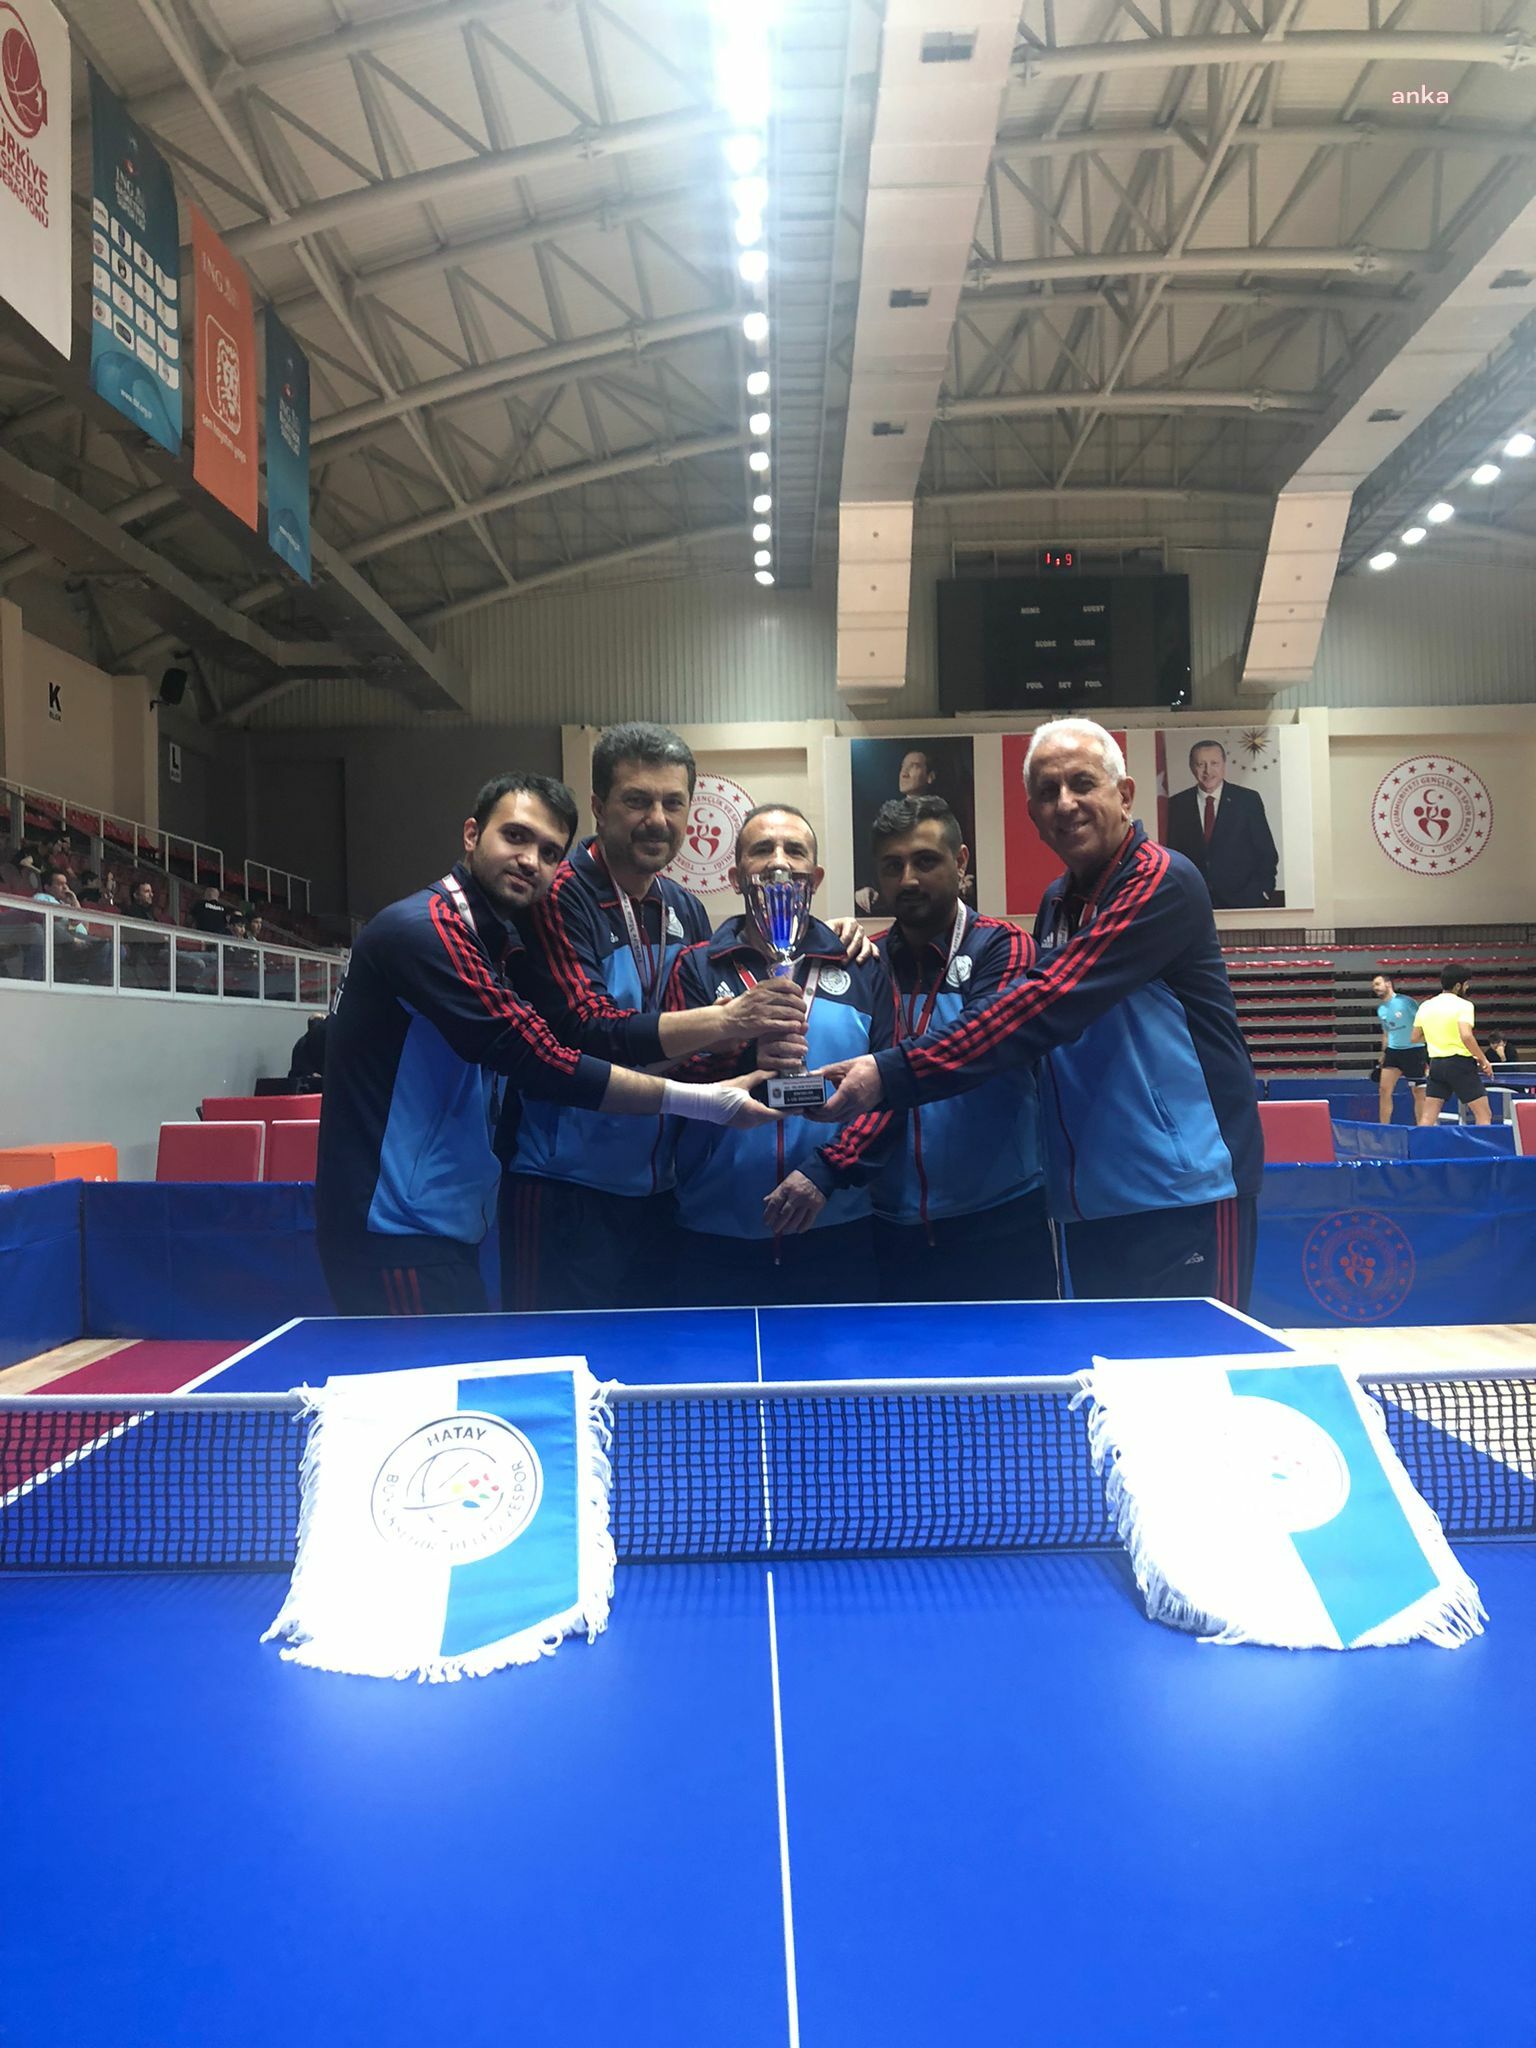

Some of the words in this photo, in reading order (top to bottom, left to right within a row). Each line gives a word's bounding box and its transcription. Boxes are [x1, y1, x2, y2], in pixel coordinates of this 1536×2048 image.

[0, 118, 48, 197] ÜRKİYE
[0, 149, 48, 215] SKETBOL
[49, 682, 61, 712] K
[172, 746, 179, 770] L
[1461, 795, 1471, 816] SPOR
[427, 1427, 487, 1446] HATAY
